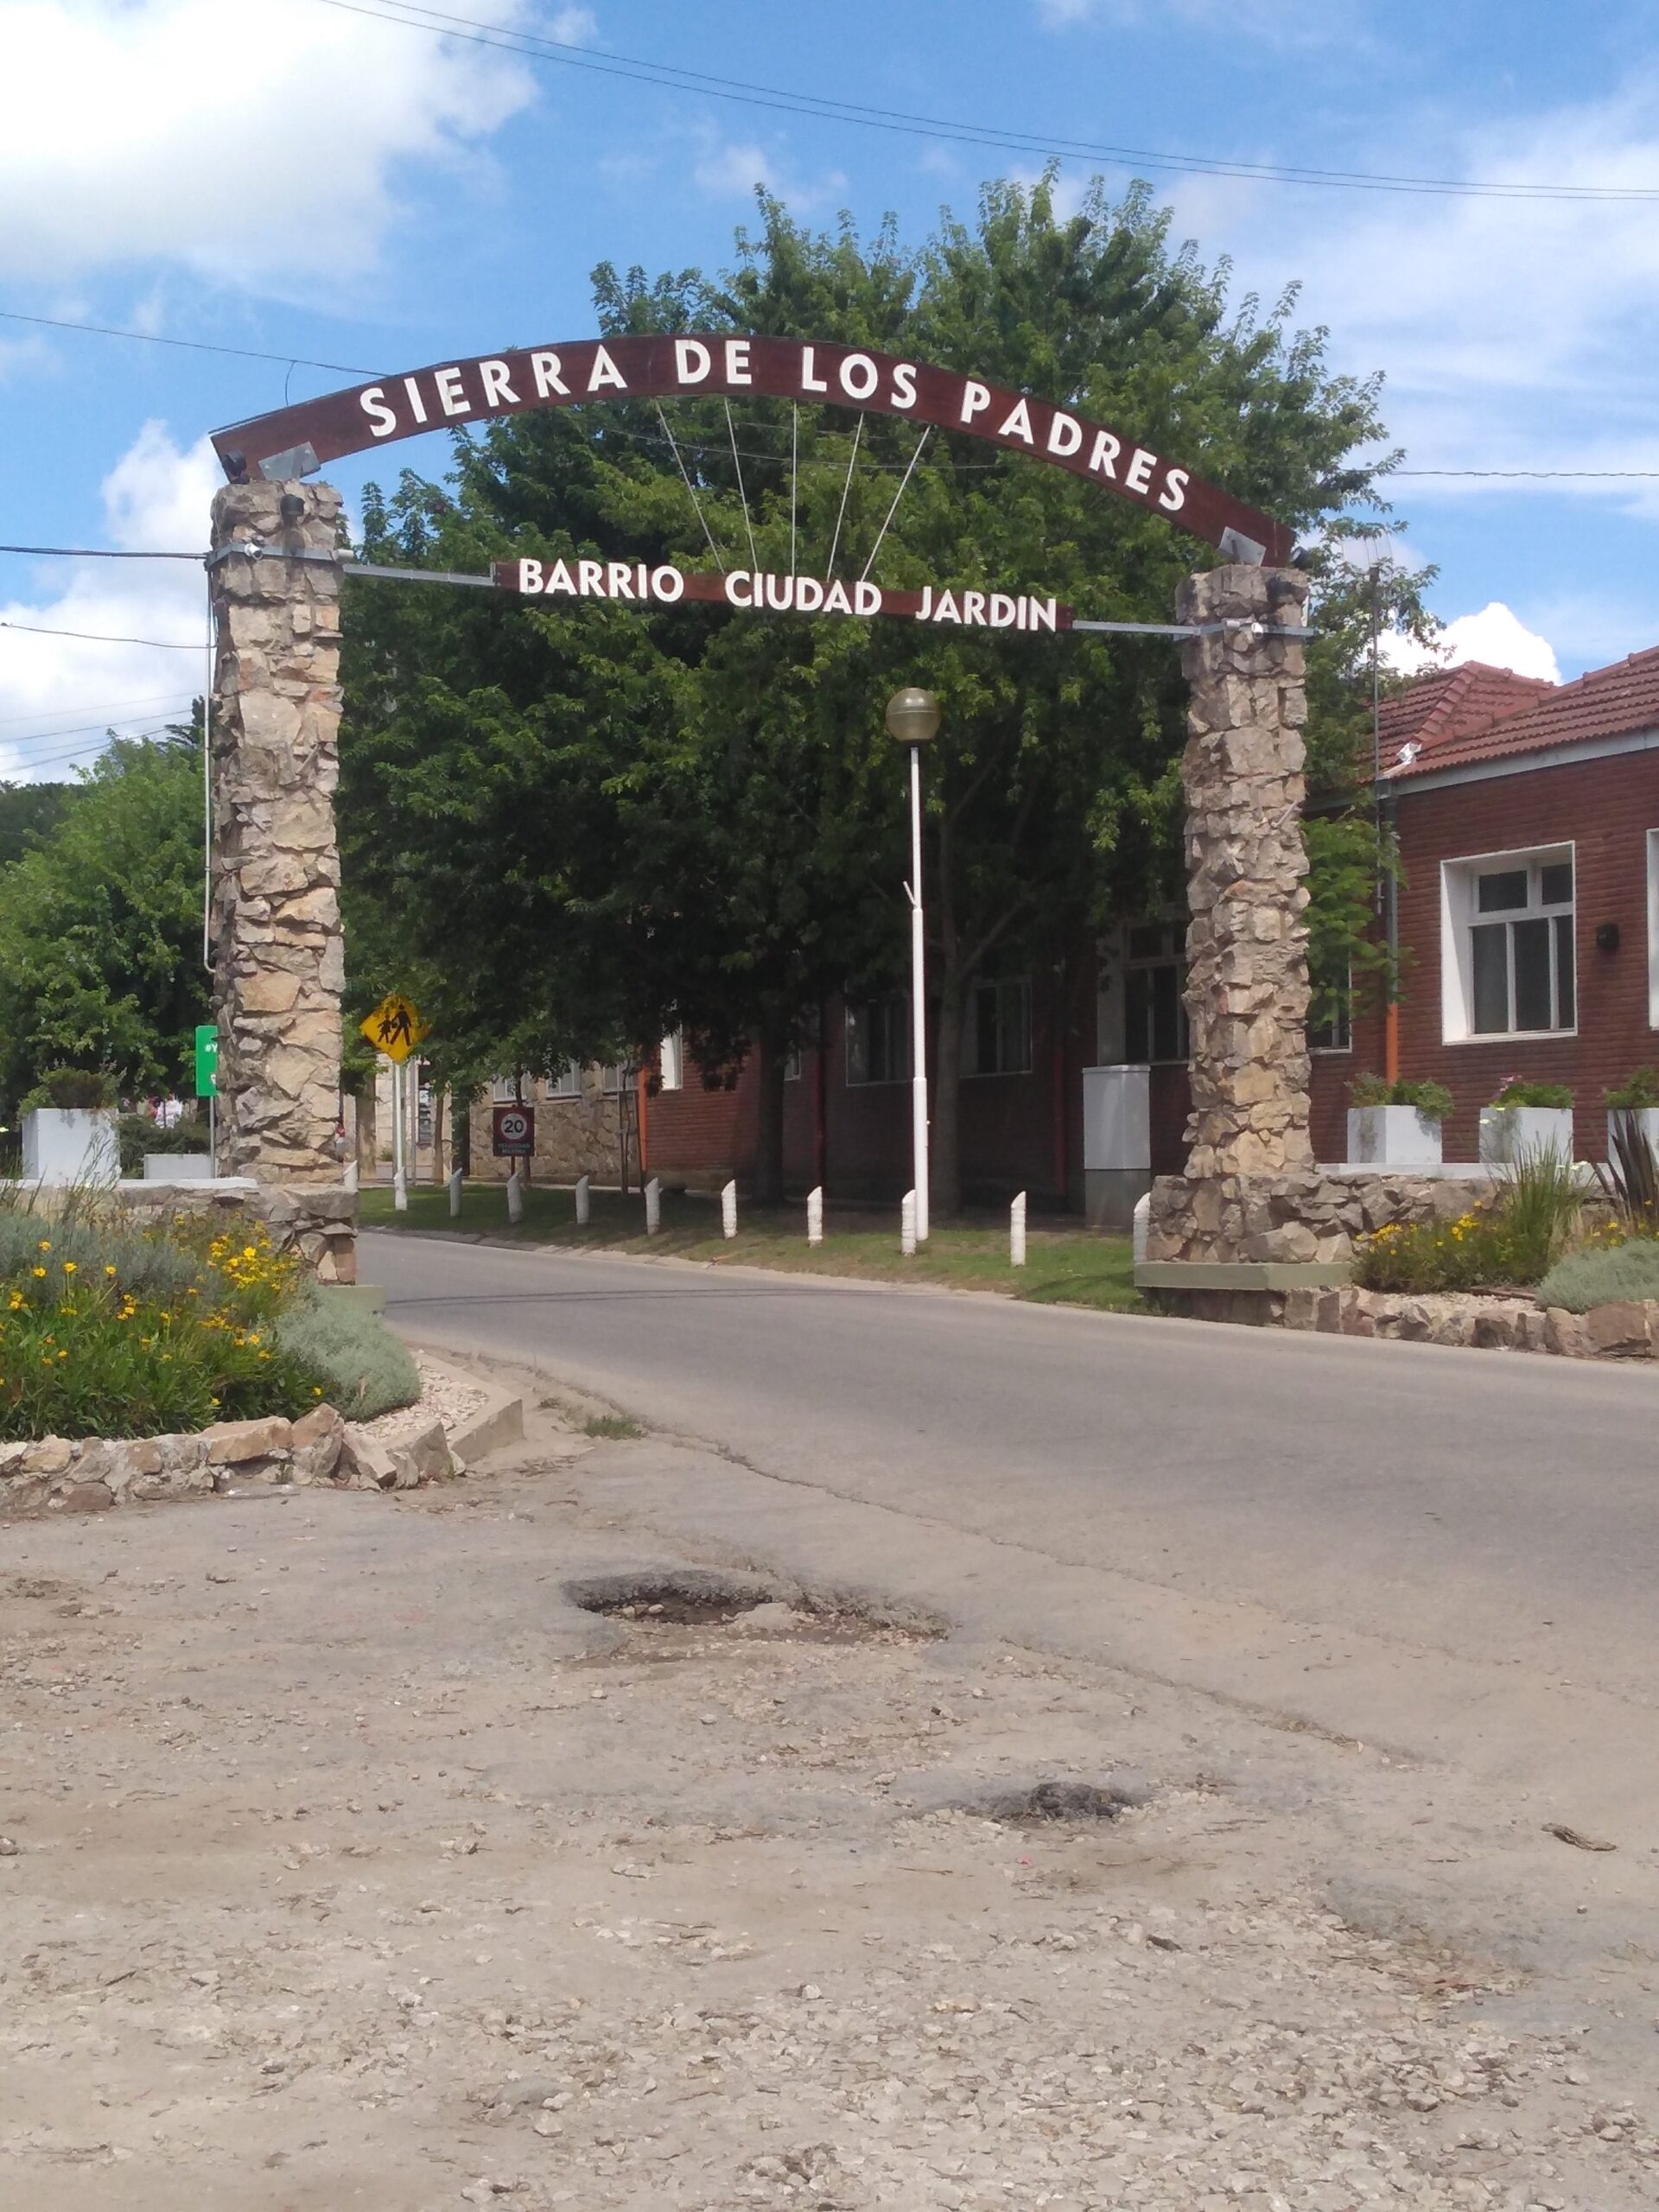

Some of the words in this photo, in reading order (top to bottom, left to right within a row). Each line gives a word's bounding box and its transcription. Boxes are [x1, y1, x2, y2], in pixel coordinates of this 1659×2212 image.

[359, 344, 629, 438] SIERRA
[674, 340, 753, 385] DE
[801, 346, 918, 410] LOS
[959, 380, 1191, 512] PADRES
[518, 557, 685, 602] BARRIO
[723, 570, 882, 616] CIUDAD
[914, 586, 1057, 632] JARDIN
[504, 1120, 524, 1134] 20
